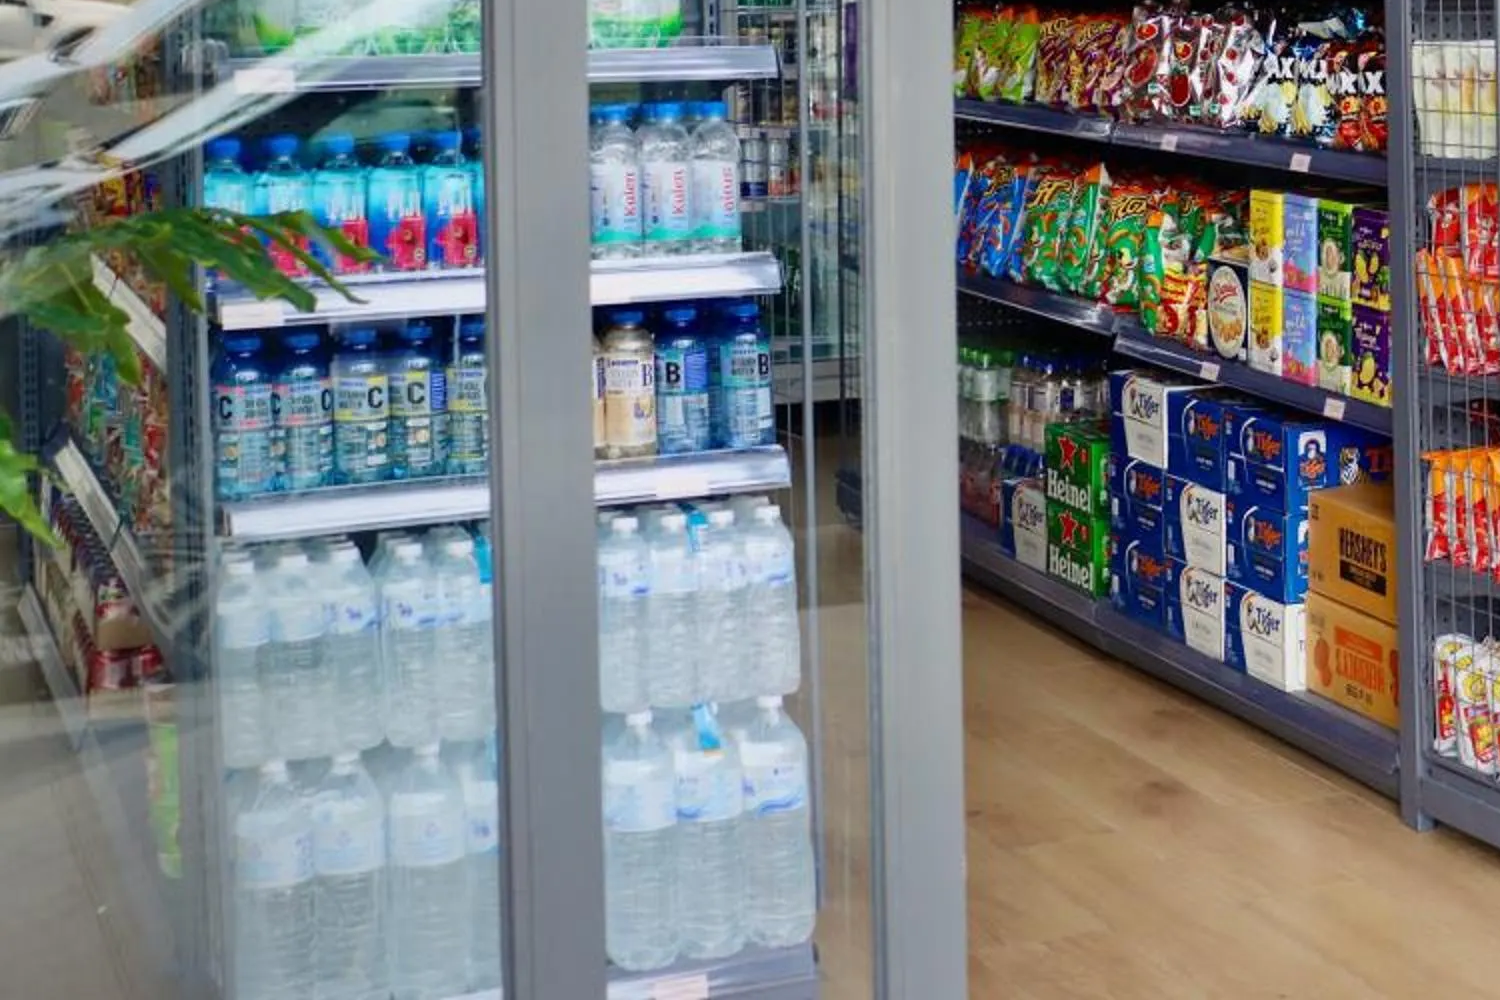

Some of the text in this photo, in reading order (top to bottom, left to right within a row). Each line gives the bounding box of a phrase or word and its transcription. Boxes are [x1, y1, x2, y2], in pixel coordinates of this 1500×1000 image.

[641, 363, 653, 387] B
[665, 361, 681, 384] B
[757, 353, 770, 376] B
[367, 386, 384, 408] C
[407, 381, 425, 404] C
[219, 396, 233, 419] C
[1138, 393, 1161, 420] Tiger
[1196, 496, 1219, 525] Tiger
[1195, 580, 1219, 609] Tiger
[1256, 606, 1281, 636] Tiger
